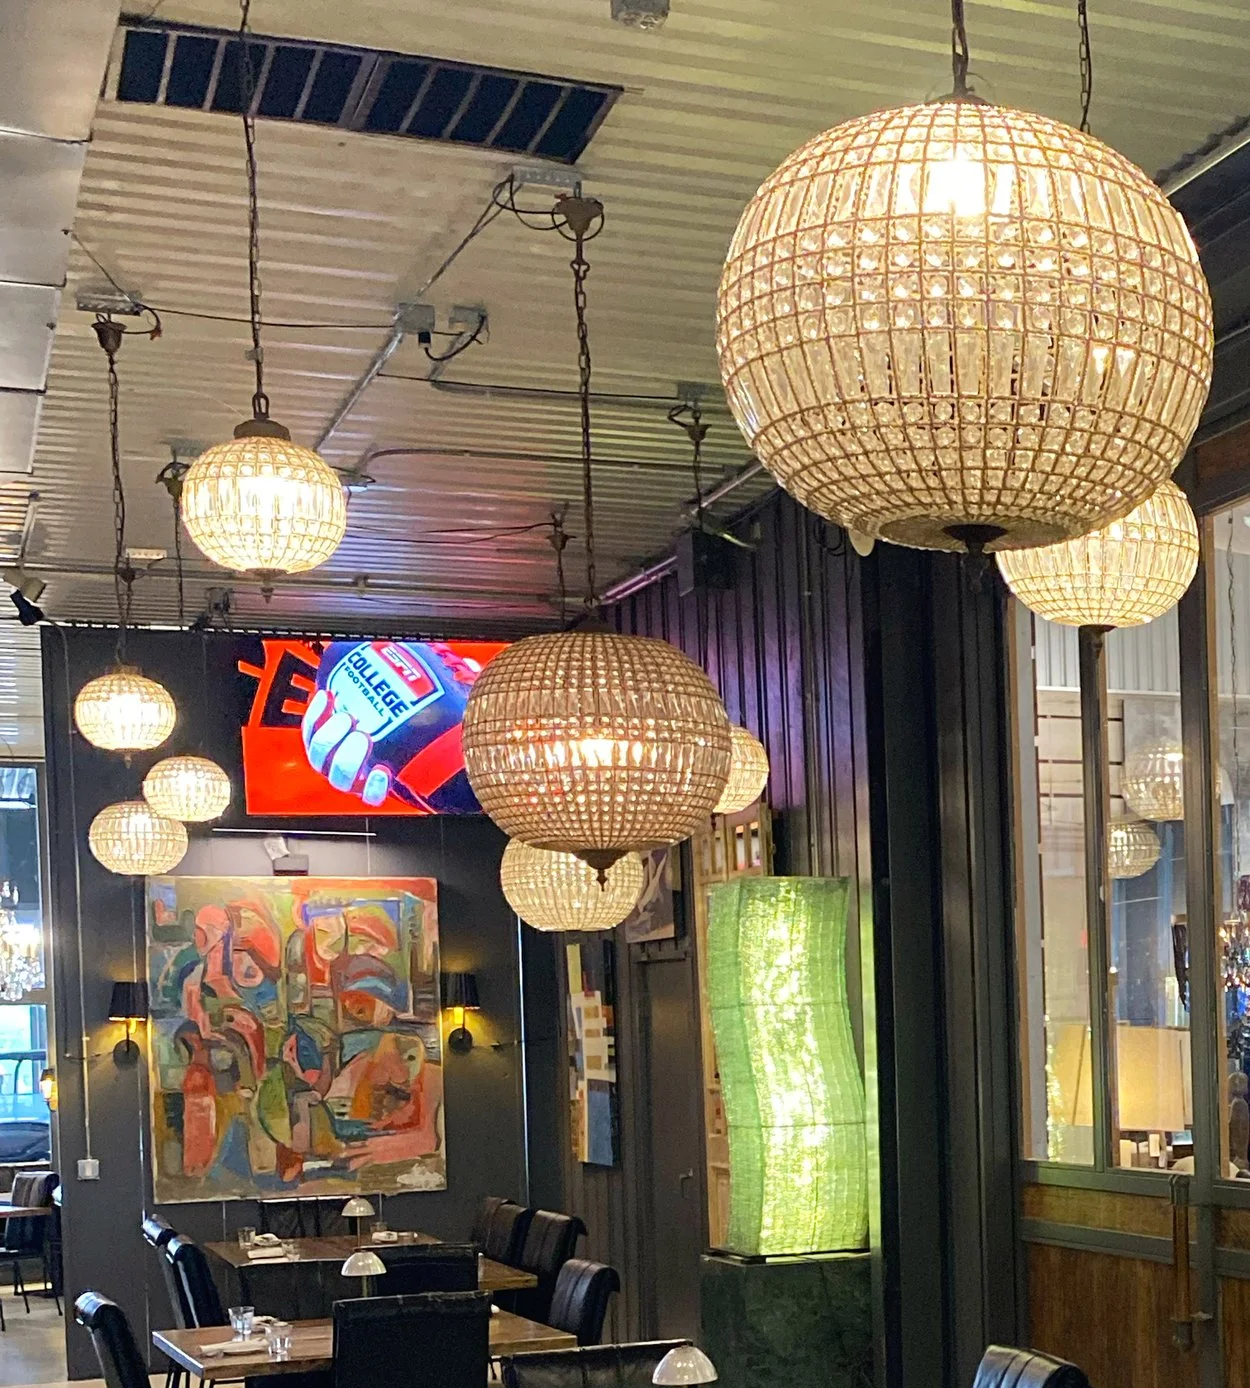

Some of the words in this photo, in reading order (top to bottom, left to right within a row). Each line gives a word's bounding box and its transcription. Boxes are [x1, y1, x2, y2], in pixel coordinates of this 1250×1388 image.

[347, 651, 409, 718] COLLEGE
[381, 646, 422, 682] ESPN
[344, 666, 384, 717] FOOTBALL
